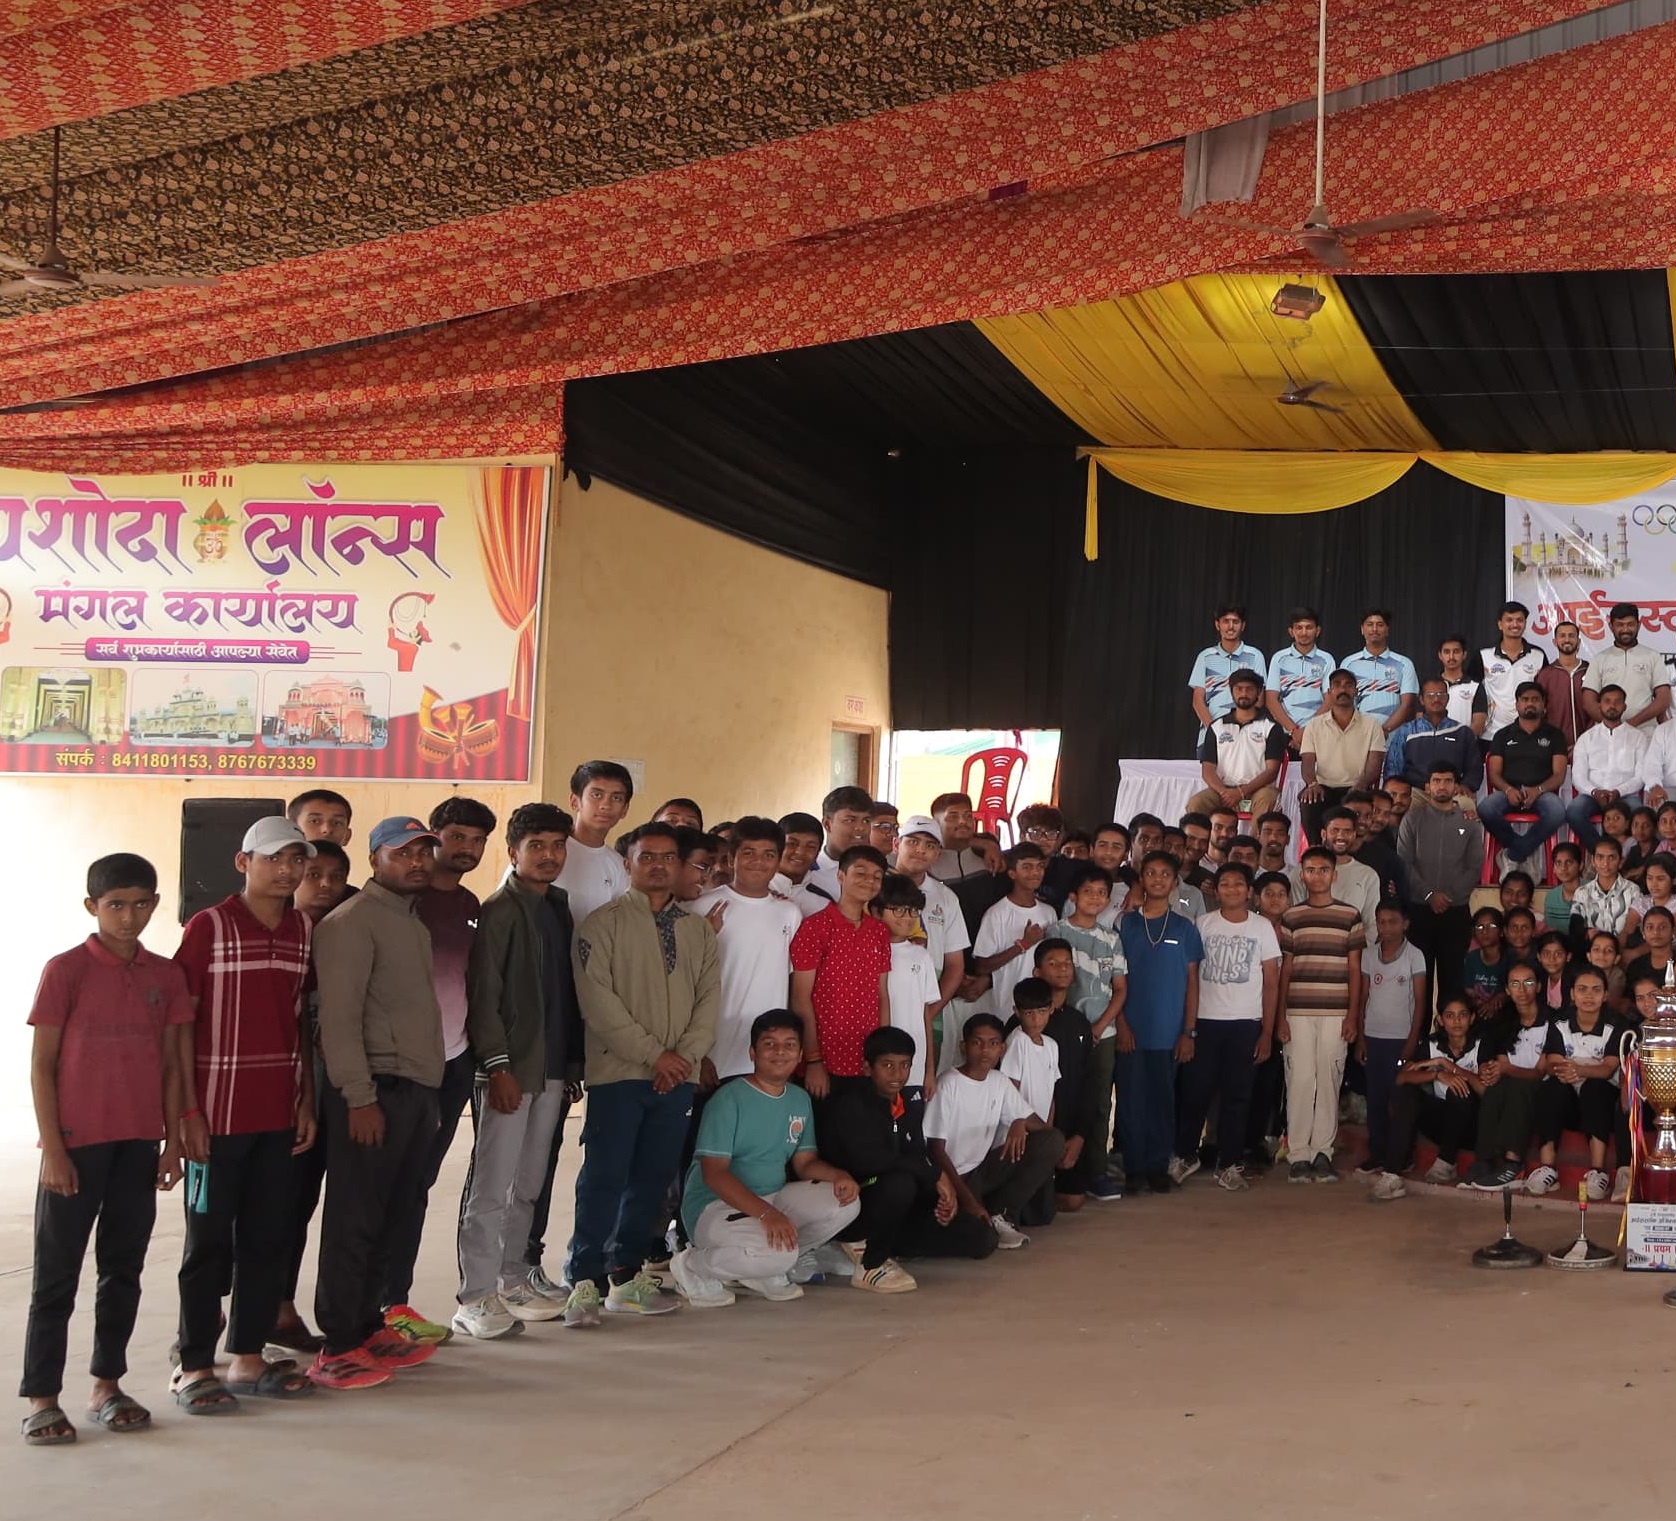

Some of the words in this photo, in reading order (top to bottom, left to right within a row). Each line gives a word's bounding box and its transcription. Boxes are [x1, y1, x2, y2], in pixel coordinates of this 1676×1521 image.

[198, 472, 217, 488] श्री
[243, 479, 452, 579] लॉन्स
[35, 579, 152, 631] मंगल
[162, 580, 363, 634] कार्यालय
[56, 749, 94, 766] संपर्क
[112, 752, 213, 770] 8411801153,
[218, 754, 317, 771] 8767673339
[1207, 945, 1248, 972] KIND
[1210, 961, 1249, 982] NESS
